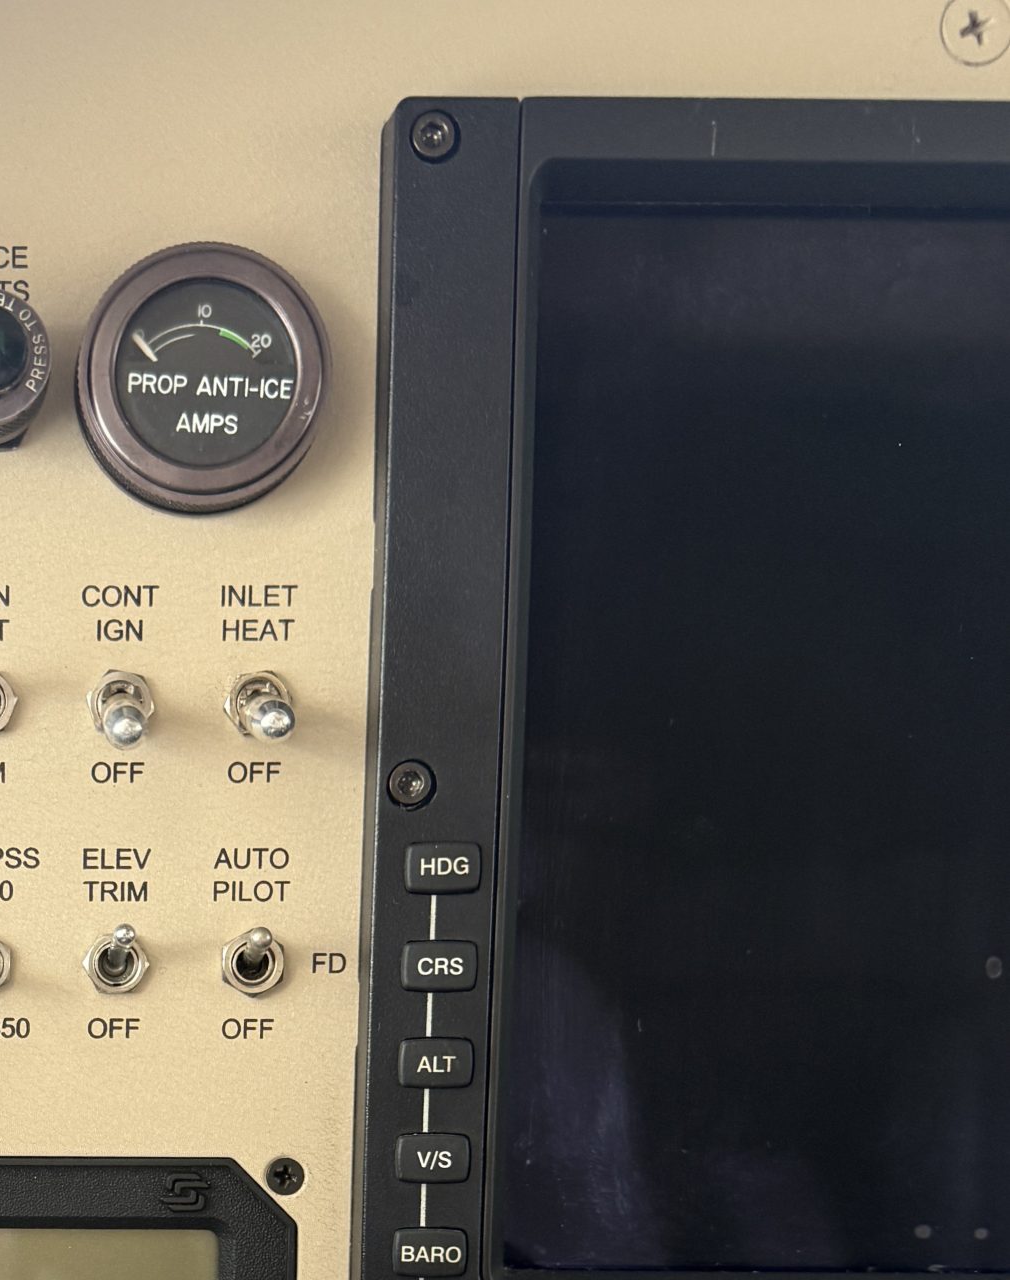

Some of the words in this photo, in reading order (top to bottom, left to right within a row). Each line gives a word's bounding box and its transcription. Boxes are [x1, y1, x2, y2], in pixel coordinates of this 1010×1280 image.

[19, 308, 37, 331] TO
[198, 304, 212, 318] 10
[250, 334, 272, 348] 20
[25, 333, 47, 393] PRESS
[127, 373, 188, 395] PROP
[196, 376, 293, 399] ANTI-ICE
[176, 412, 239, 434] AMPS
[81, 584, 160, 608] CONT
[221, 584, 299, 607] INLET
[96, 618, 144, 642] IGN
[222, 618, 296, 642] HEAT
[91, 761, 145, 784] OFF
[227, 761, 282, 784] OFF
[82, 847, 152, 870] ELEV
[213, 847, 290, 870] AUTO
[420, 856, 469, 876] HDG
[82, 880, 148, 902] TRIM
[213, 880, 291, 903] PILOT
[312, 952, 347, 974] FD
[417, 957, 464, 976] CRS
[87, 1017, 141, 1040] OFF
[221, 1017, 275, 1040] OFF
[416, 1055, 457, 1073] ALT
[416, 1150, 452, 1170] V/S
[401, 1245, 462, 1264] BARO
